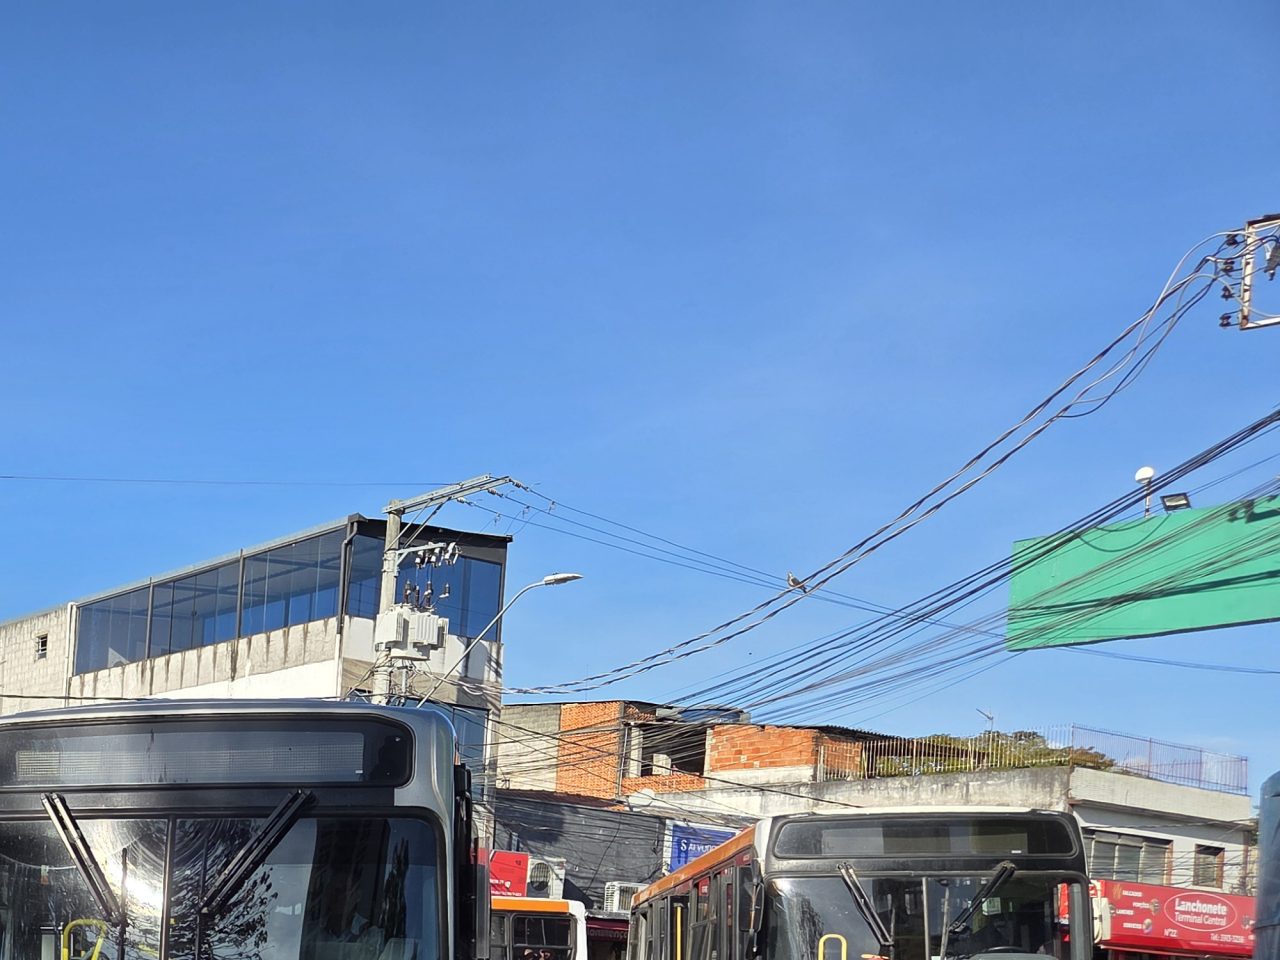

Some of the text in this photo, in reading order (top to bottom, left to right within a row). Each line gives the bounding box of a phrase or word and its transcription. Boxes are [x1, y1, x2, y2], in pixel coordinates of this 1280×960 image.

[1175, 898, 1228, 915] Lanchonete
[1175, 911, 1227, 927] Terminal Central
